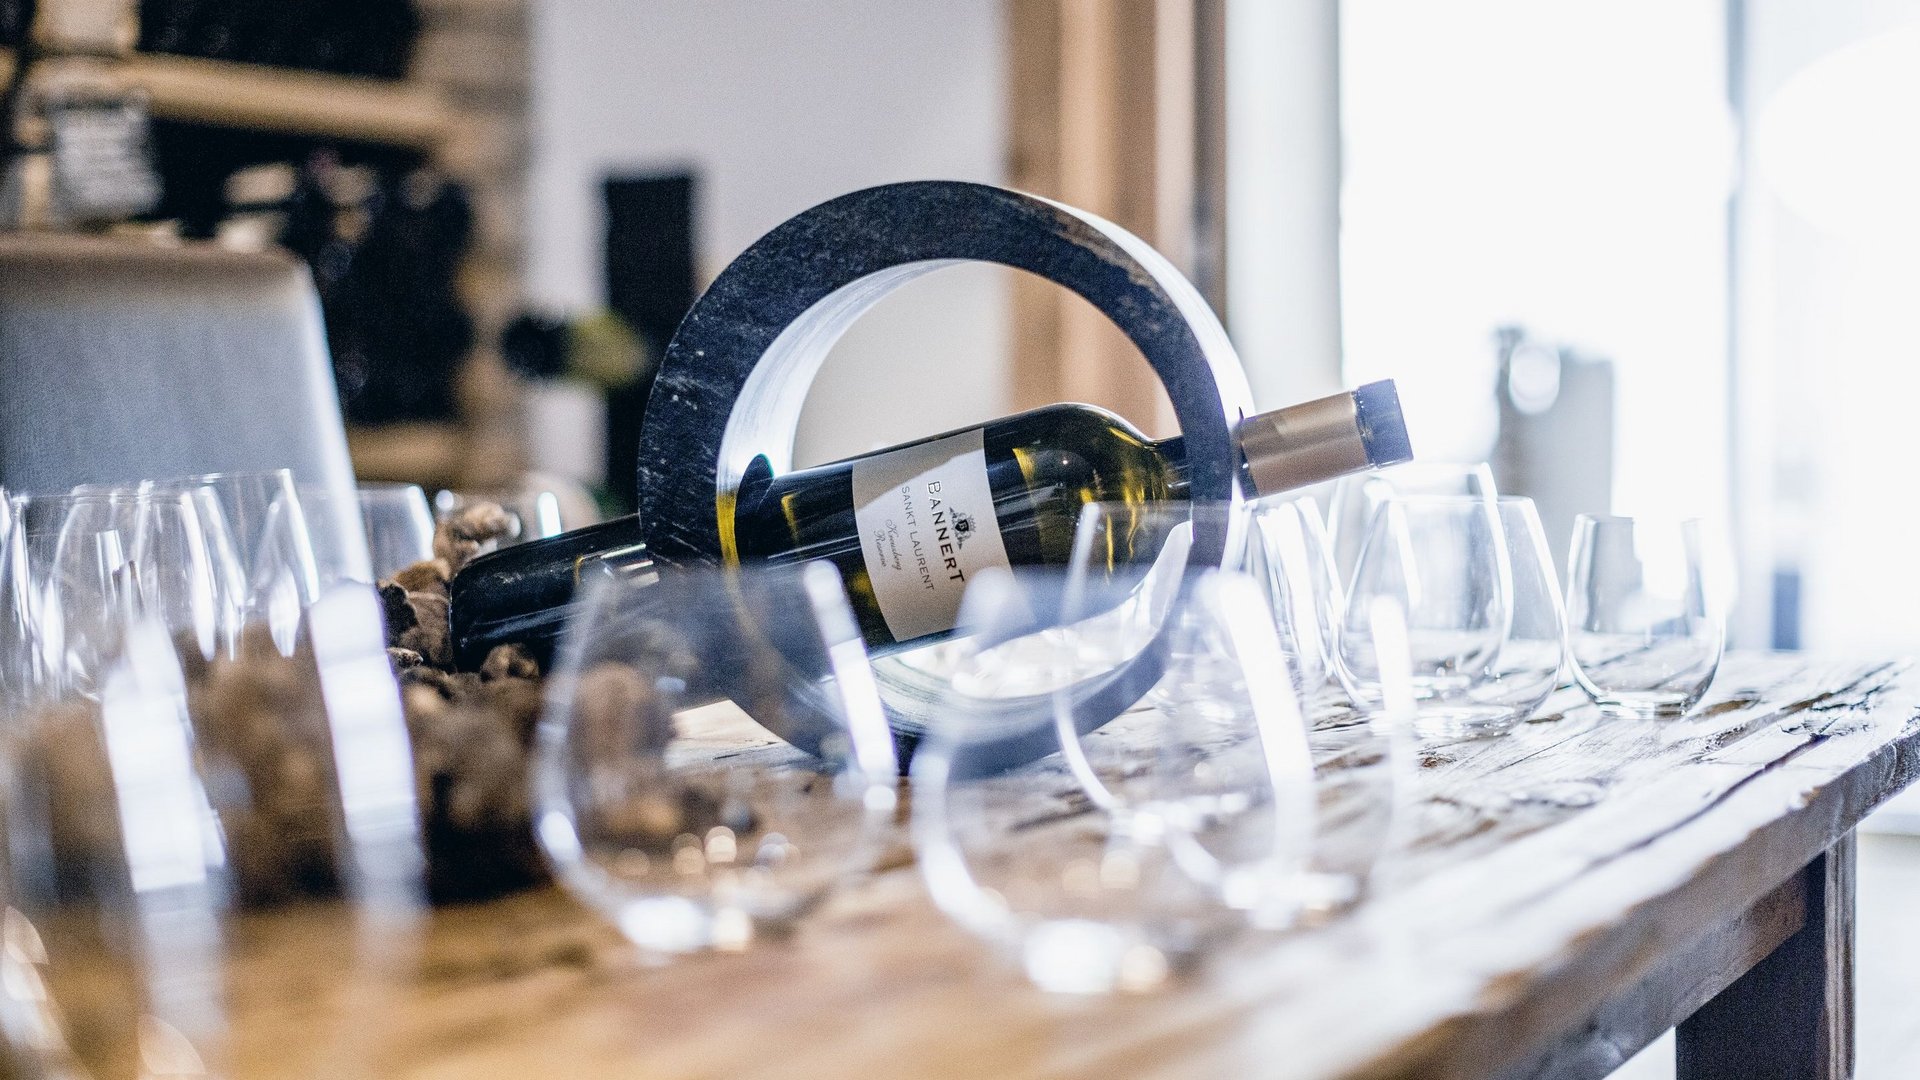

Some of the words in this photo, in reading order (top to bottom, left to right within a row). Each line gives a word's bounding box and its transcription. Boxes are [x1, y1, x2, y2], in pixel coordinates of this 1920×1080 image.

[902, 486, 917, 526] SANKT
[928, 480, 965, 582] BANNERT
[909, 530, 934, 590] LAURENT
